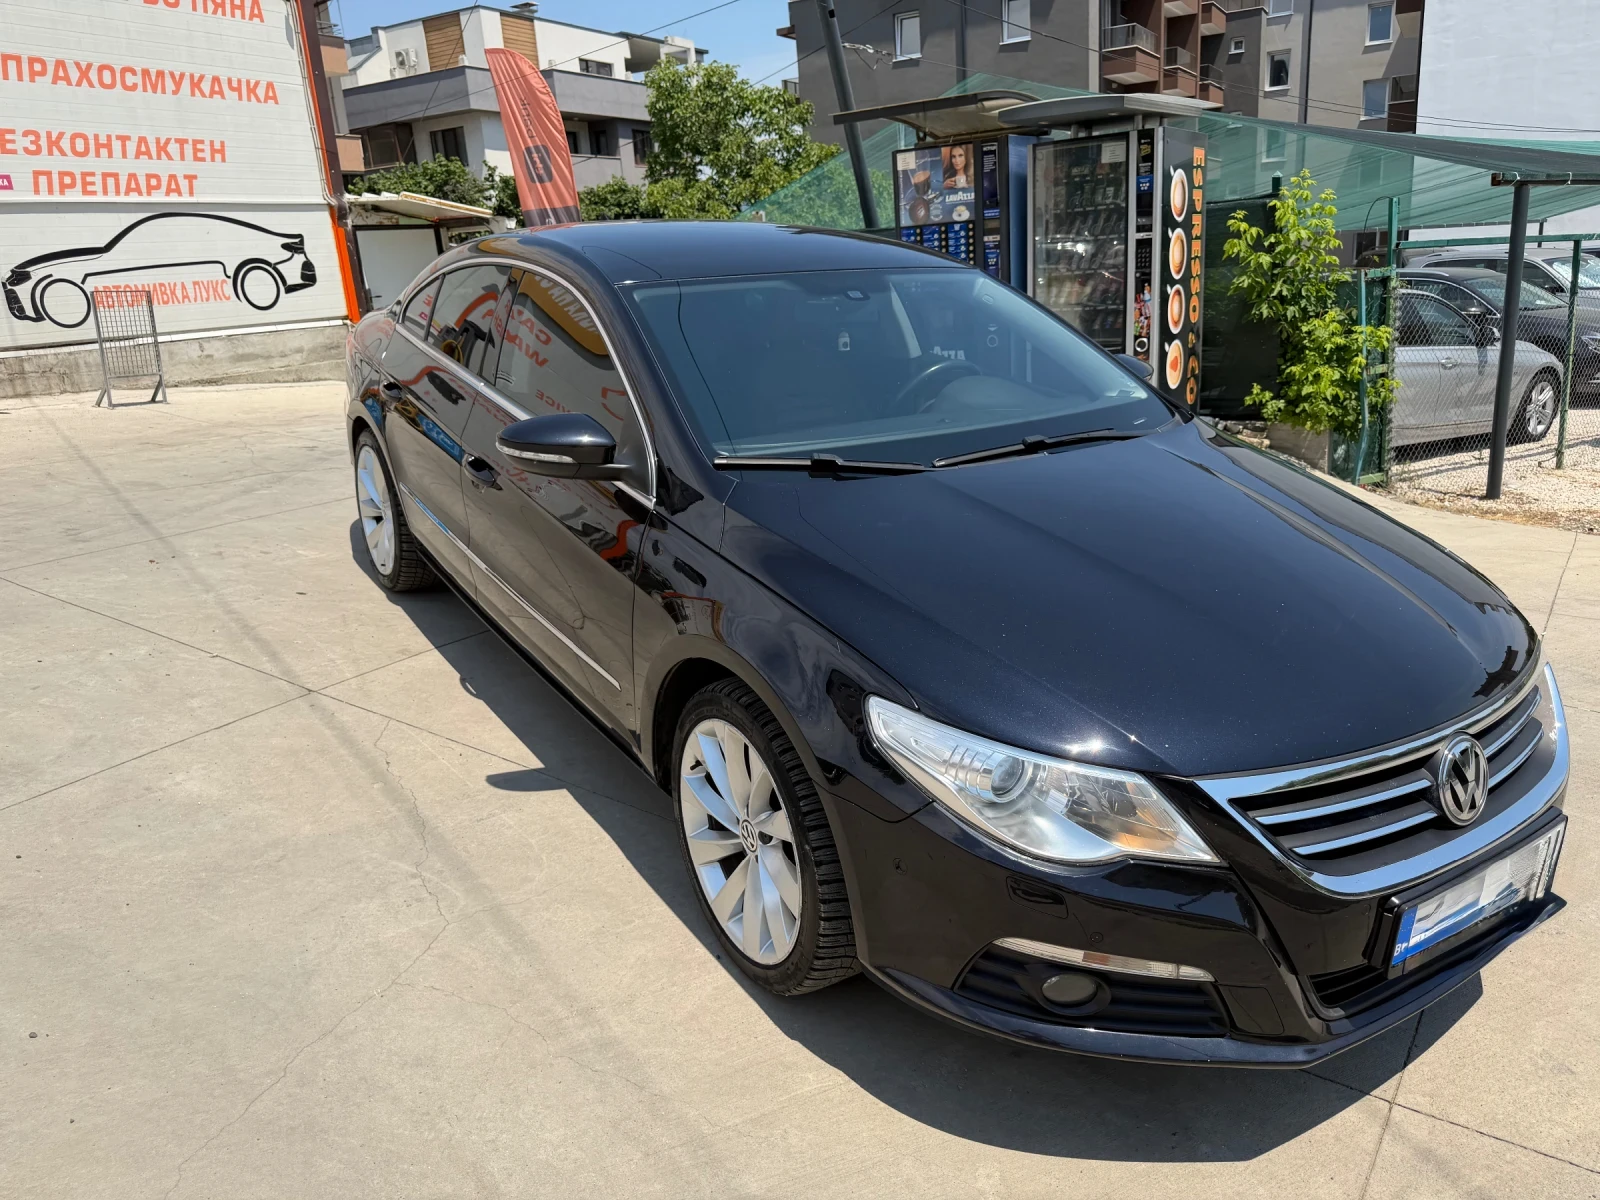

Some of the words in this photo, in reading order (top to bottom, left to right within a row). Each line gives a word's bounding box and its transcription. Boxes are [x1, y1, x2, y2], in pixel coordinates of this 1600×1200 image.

[1, 53, 279, 105] ПРАХОСМУКАЧКА
[32, 169, 198, 197] ПРЕПАРАТ
[1189, 146, 1205, 324] ESPRESSO
[191, 279, 231, 302] ЛУКС
[1186, 355, 1199, 405] CO
